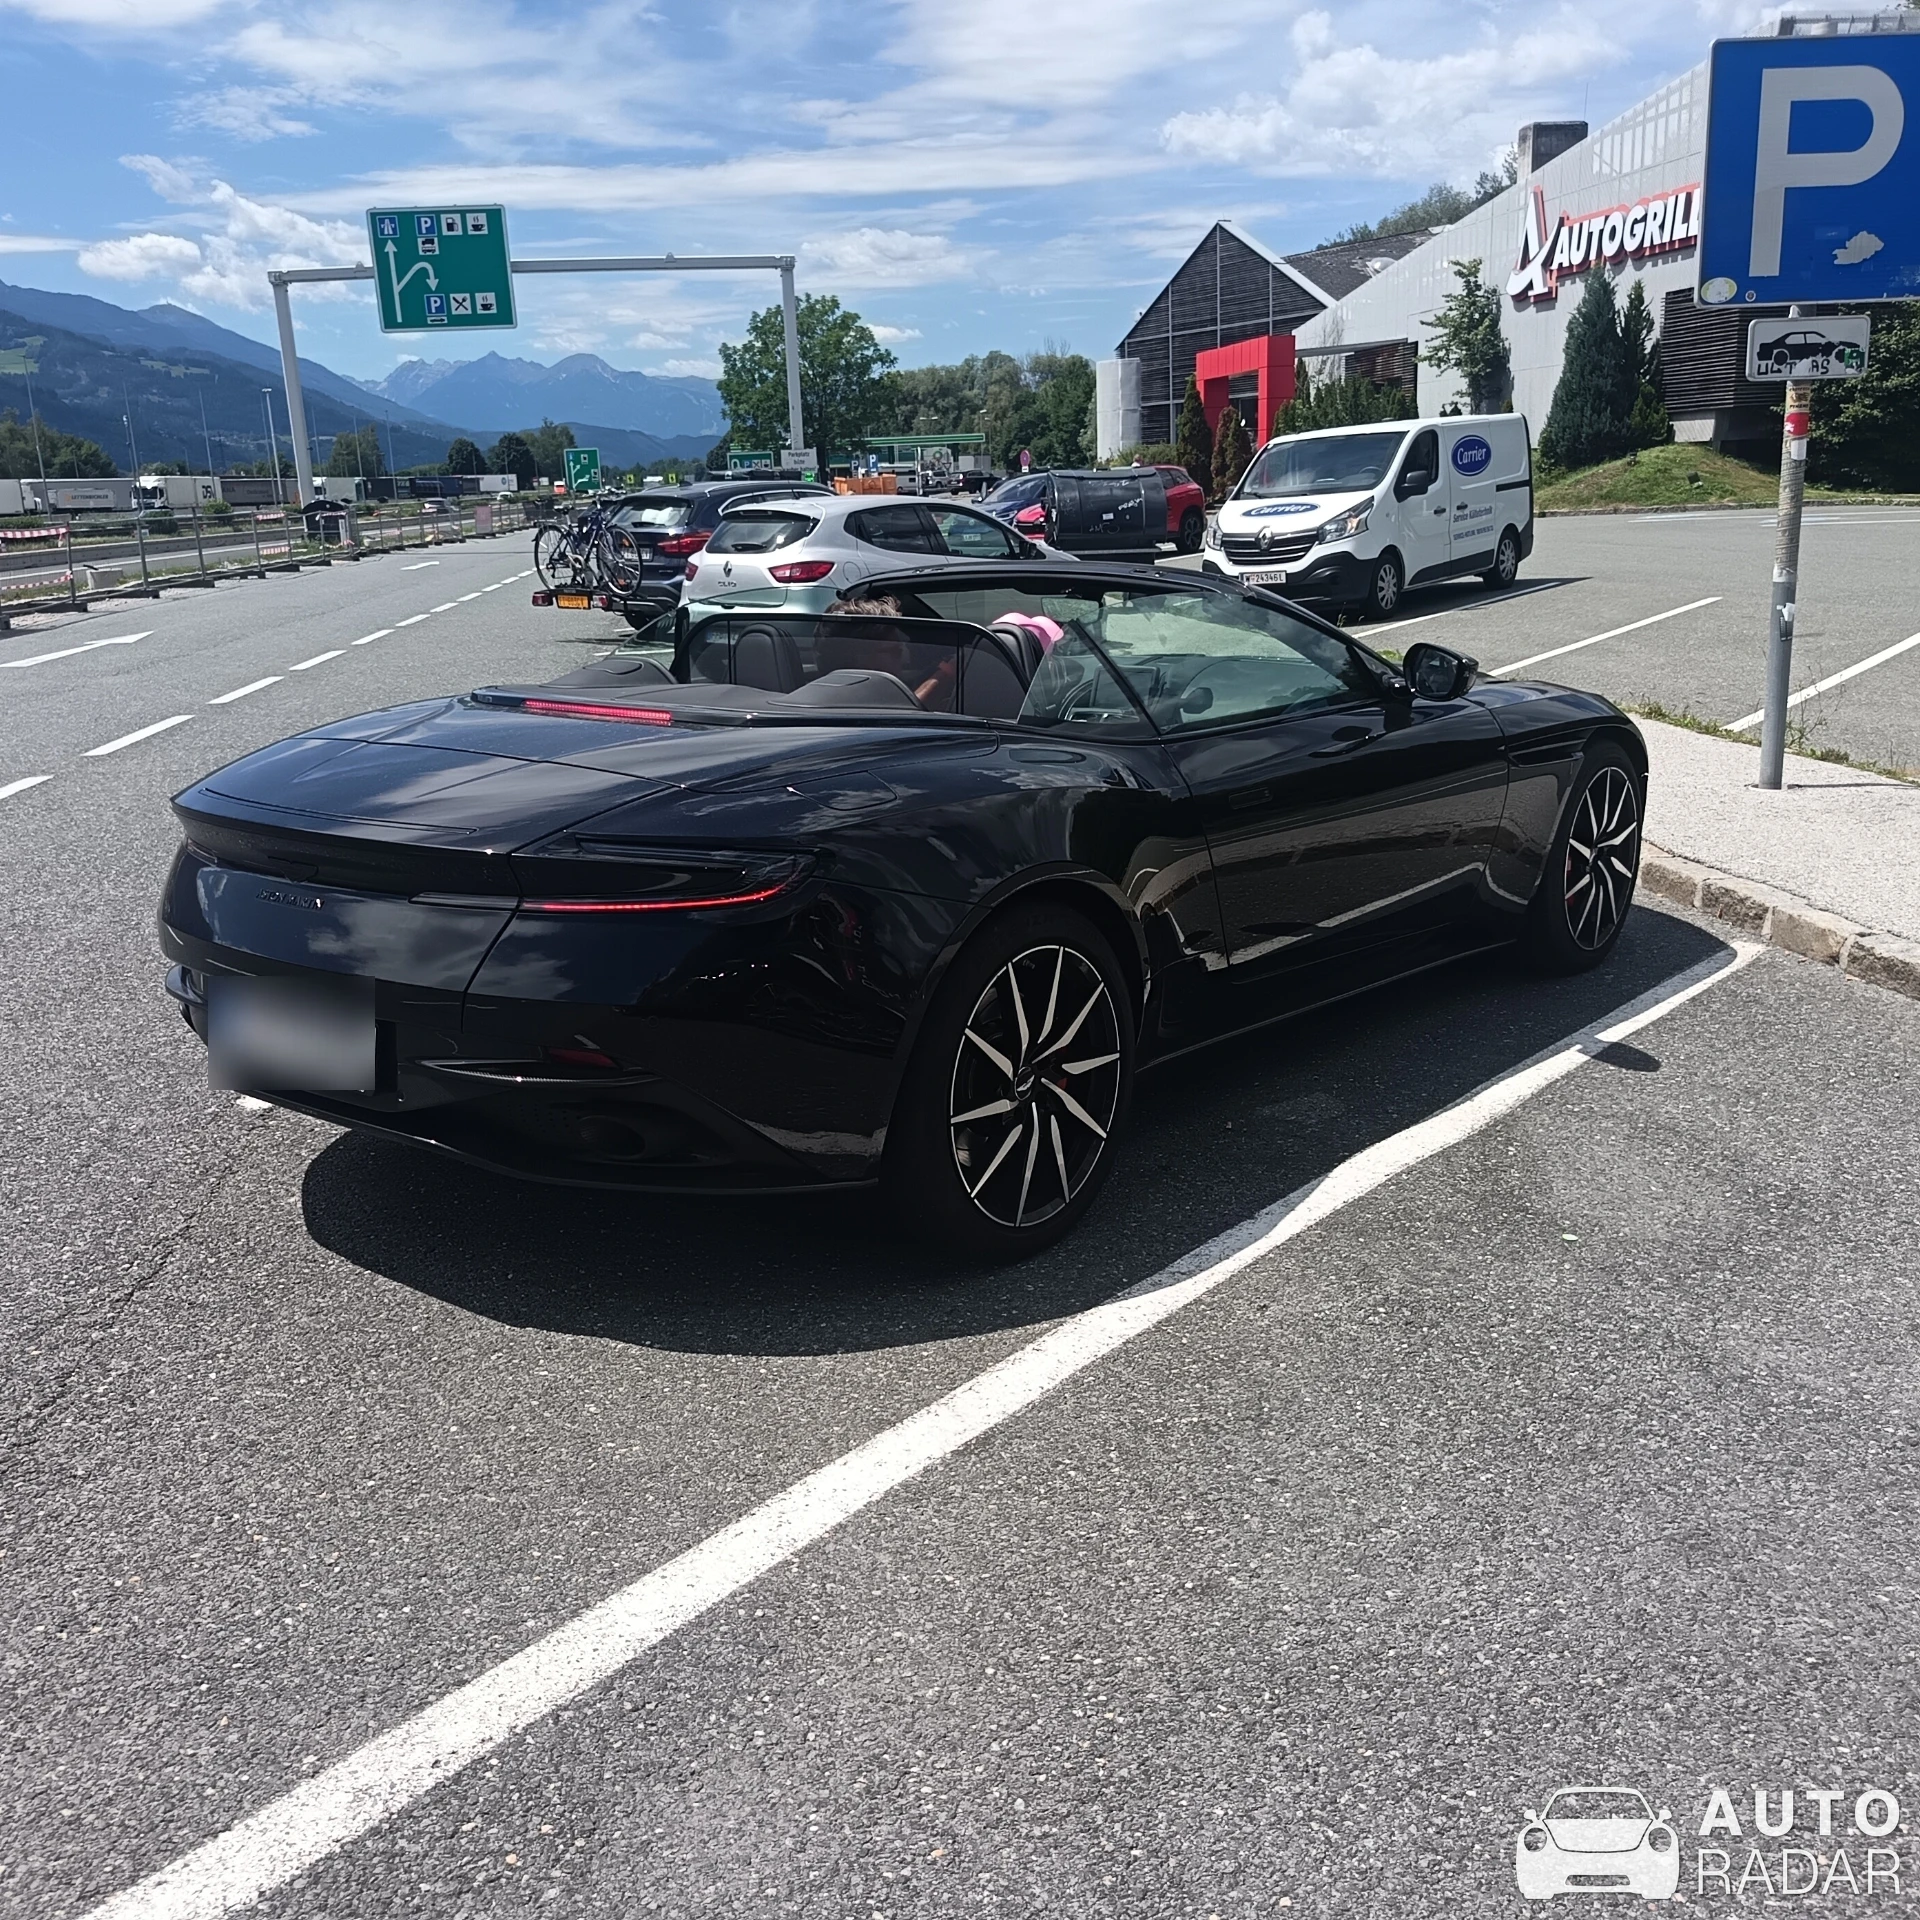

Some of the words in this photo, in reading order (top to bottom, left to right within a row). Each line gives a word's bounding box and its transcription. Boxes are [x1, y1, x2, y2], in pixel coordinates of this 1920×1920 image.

[1749, 65, 1905, 277] P
[420, 217, 432, 234] P
[430, 297, 441, 313] P
[1757, 359, 1830, 376] ULTAS
[869, 454, 876, 472] P
[1457, 446, 1487, 465] Carrier
[851, 460, 859, 470] P
[1251, 504, 1311, 515] Carrier
